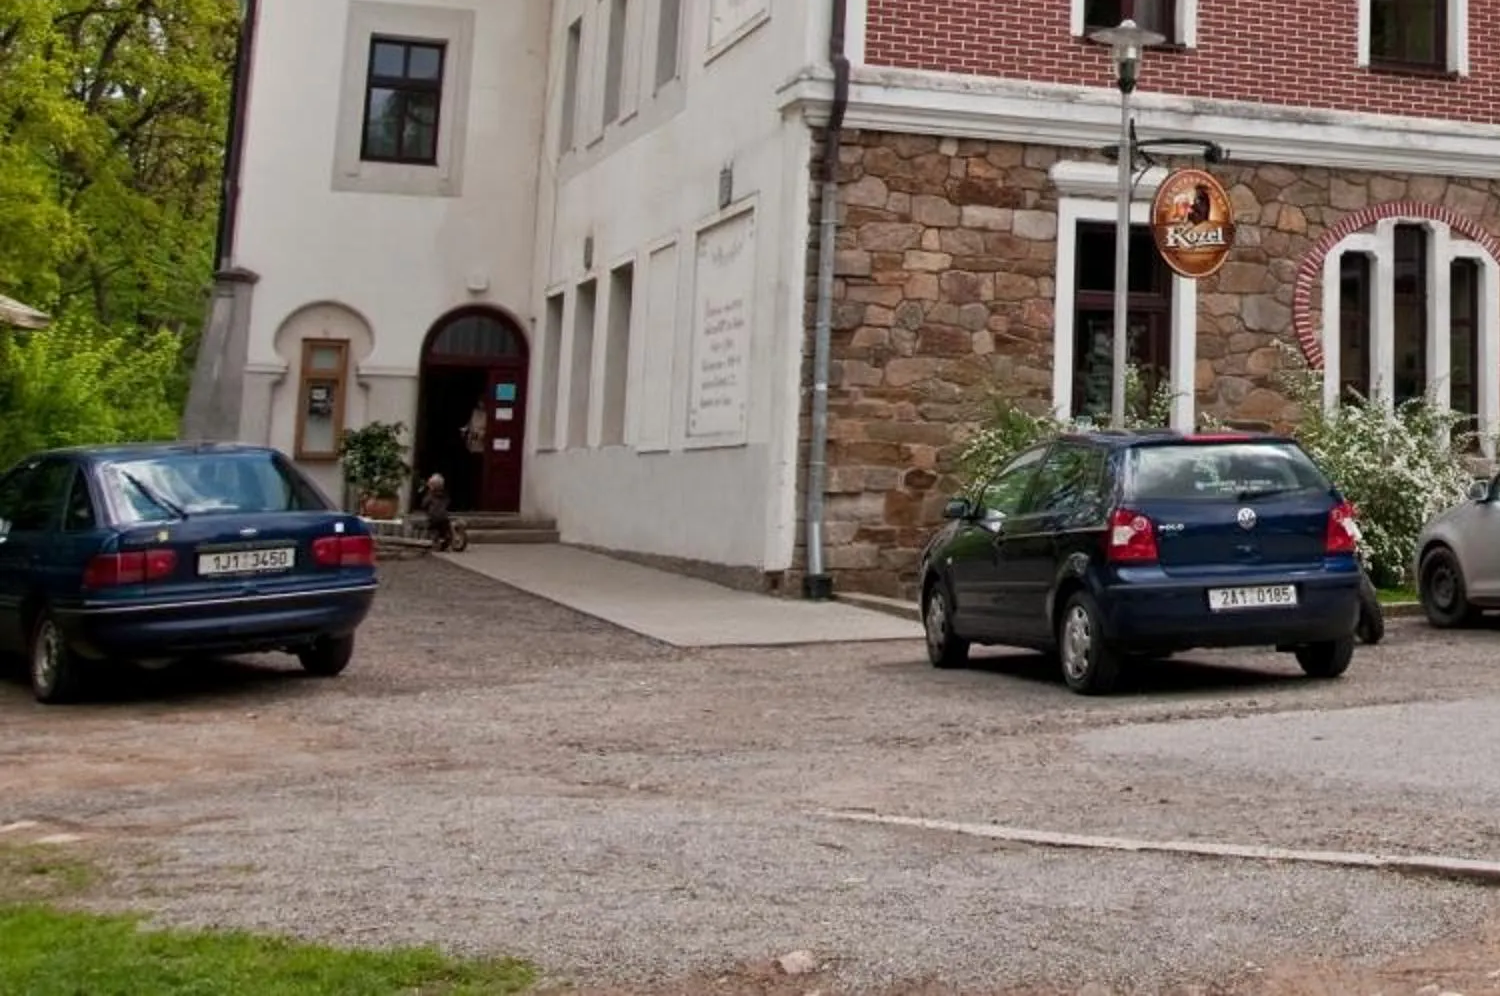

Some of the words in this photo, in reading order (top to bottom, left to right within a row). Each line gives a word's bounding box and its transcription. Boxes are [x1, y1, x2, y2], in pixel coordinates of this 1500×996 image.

[212, 553, 240, 571] 1J1
[251, 550, 288, 568] 3450
[1220, 588, 1248, 606] 2A1
[1256, 585, 1291, 603] 0185
